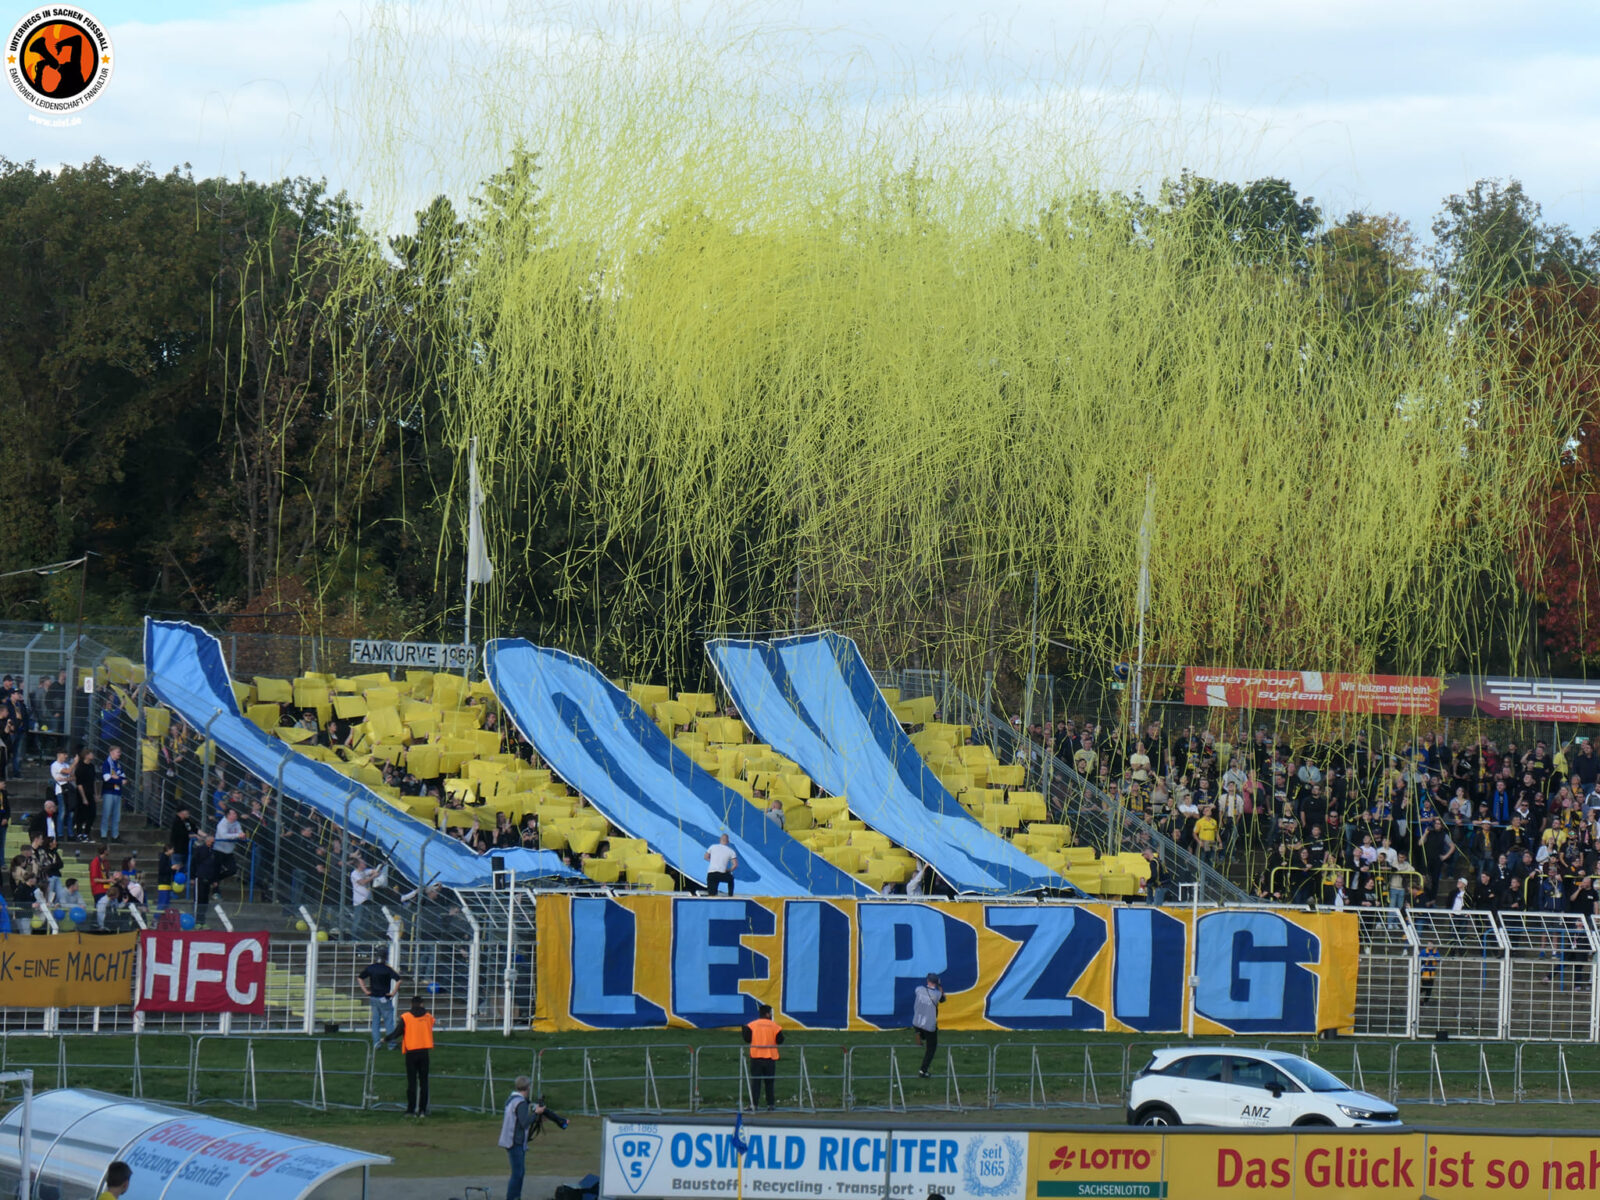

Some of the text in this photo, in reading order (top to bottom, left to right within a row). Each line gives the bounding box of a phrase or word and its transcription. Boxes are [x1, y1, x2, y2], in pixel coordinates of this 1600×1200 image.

[353, 642, 475, 667] FANKURVE 1966
[1195, 674, 1300, 689] waterproof
[1340, 681, 1355, 692] Wir
[1357, 683, 1387, 693] heizen
[1388, 685, 1411, 694] euch
[1257, 691, 1335, 702] systems
[1499, 702, 1596, 715] SPAUKE HOLDING
[65, 950, 133, 982] MACHT
[143, 937, 263, 1005] HFC
[570, 896, 1321, 1033] LEIPZIG
[1241, 1104, 1272, 1119] AMZ
[618, 1124, 658, 1134] seit 1865
[148, 1123, 292, 1177] Blumenberg
[622, 1140, 652, 1158] OR
[670, 1131, 960, 1173] OSWALD RICHTER
[982, 1143, 1002, 1160] seit
[126, 1145, 230, 1188] Heizung Sanitär
[1080, 1148, 1152, 1170] LOTTO
[1217, 1148, 1291, 1189] Das
[1304, 1146, 1416, 1188] Glück
[1428, 1145, 1476, 1188] ist
[1485, 1159, 1531, 1189] so
[630, 1161, 643, 1178] S
[979, 1160, 1005, 1177] 1865
[672, 1178, 956, 1197] Baustoff Recycling Transport Bau
[1078, 1184, 1151, 1196] SACHSENLOTTO
